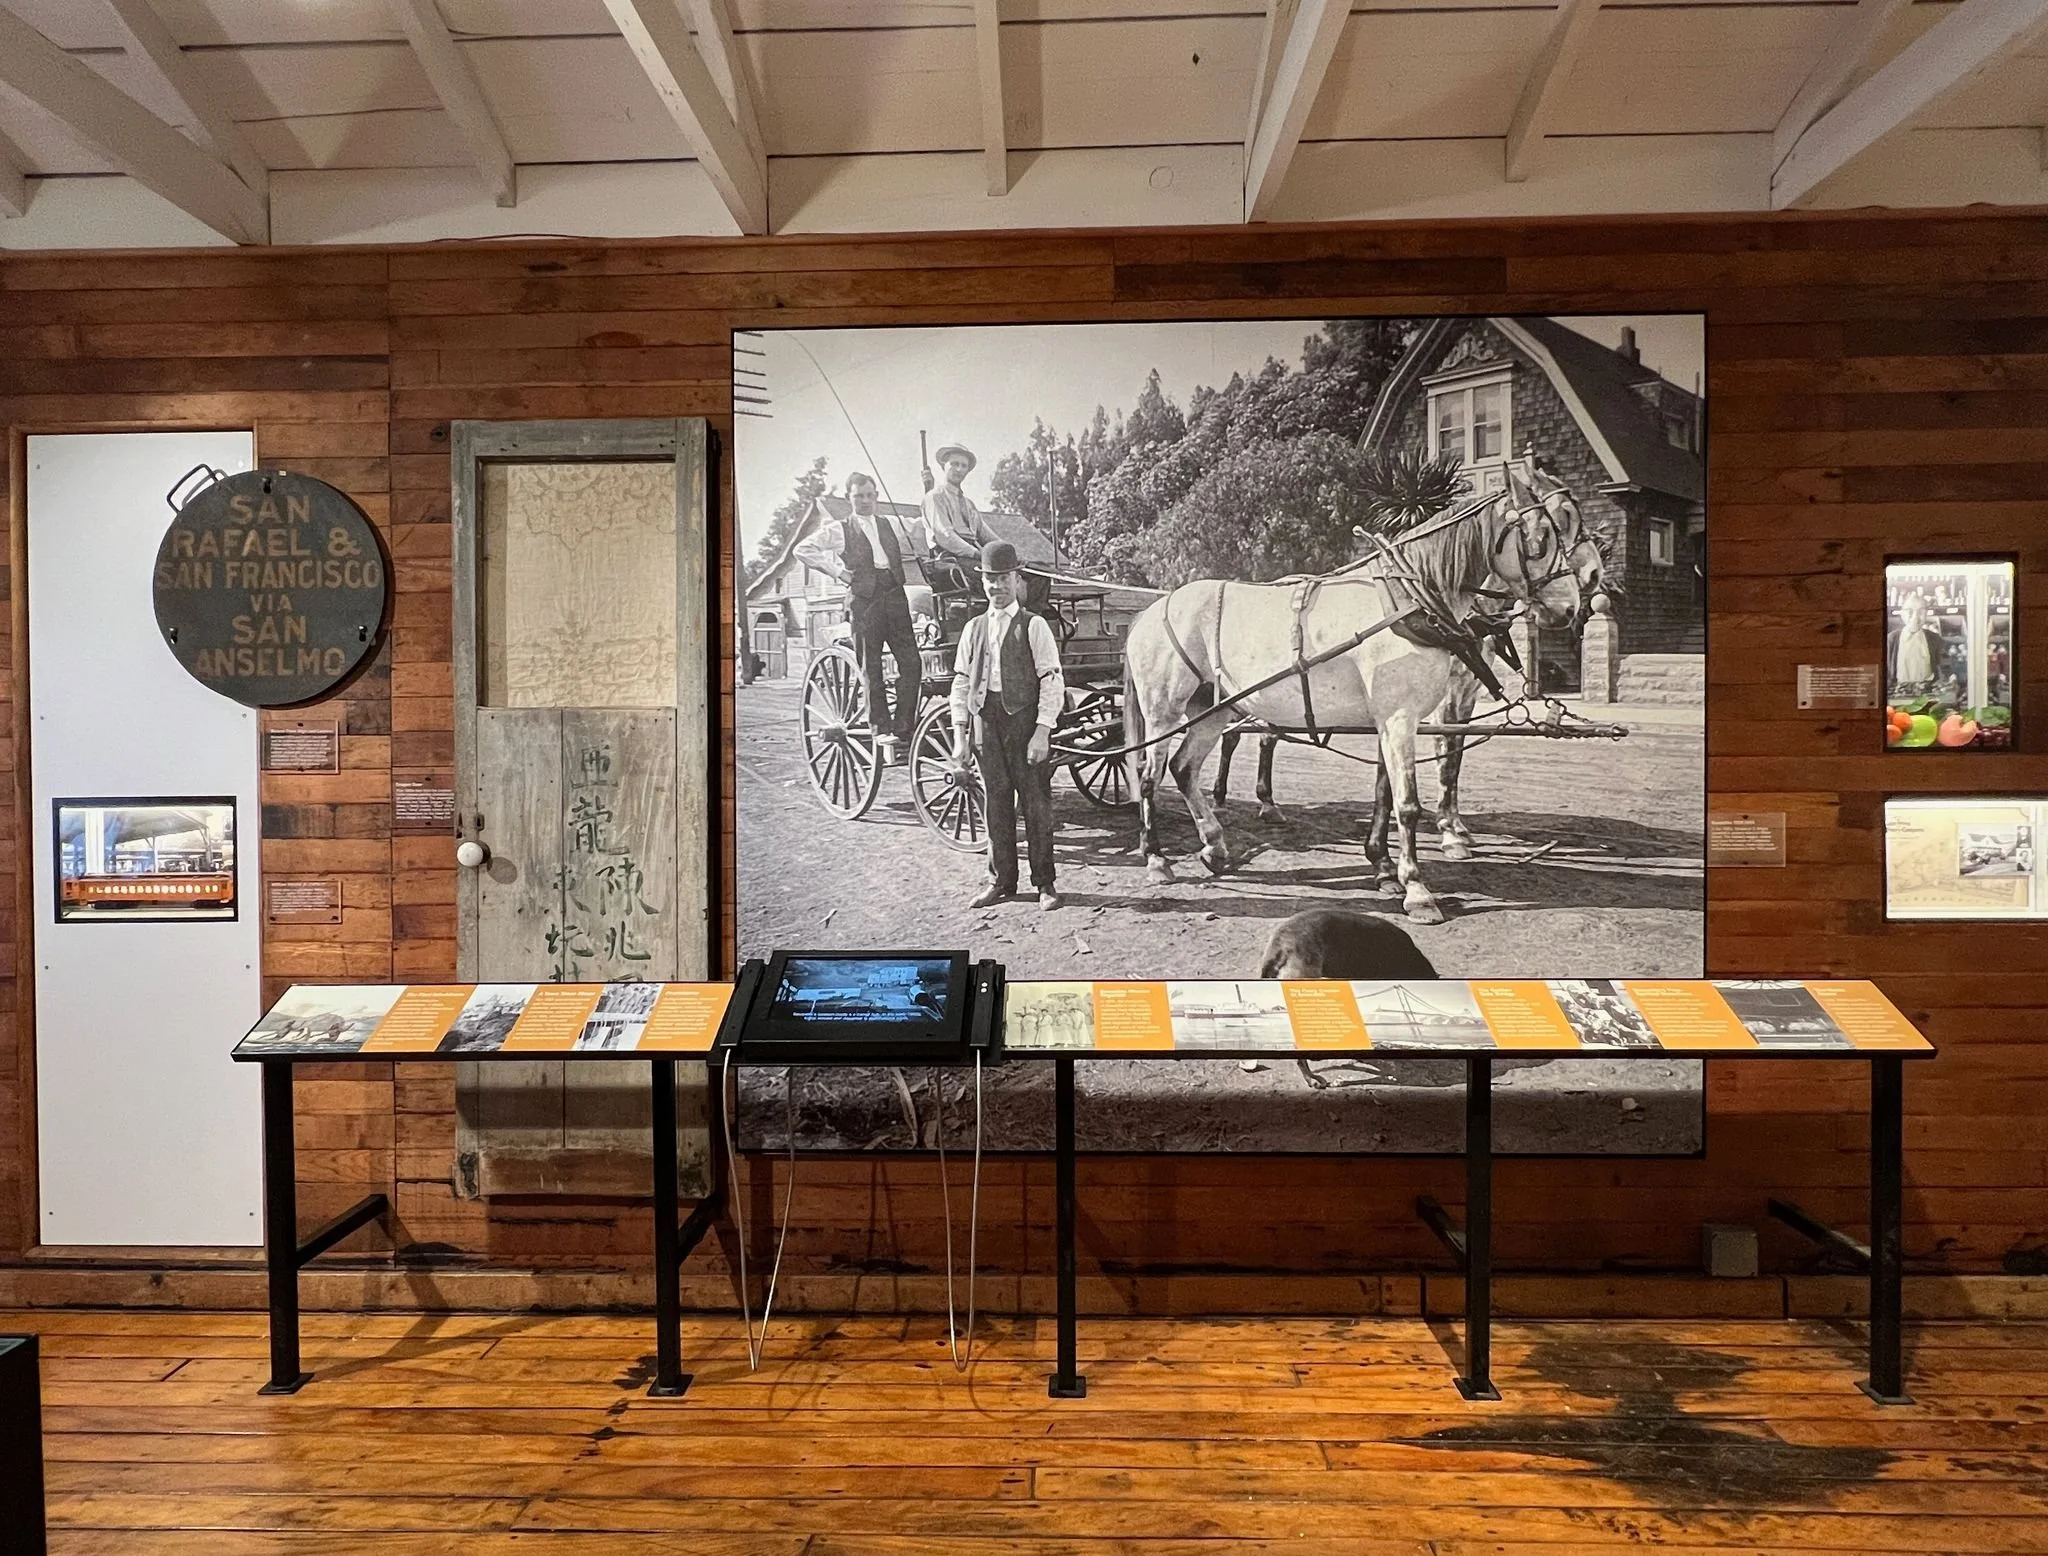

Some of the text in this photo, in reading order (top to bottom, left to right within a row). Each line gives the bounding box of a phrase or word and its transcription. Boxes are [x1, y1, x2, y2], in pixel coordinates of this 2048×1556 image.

[230, 495, 311, 525] SAN
[172, 527, 362, 558] RAFAEL &
[156, 559, 381, 589] SAN FRANCISCO
[250, 594, 293, 613] VIA
[232, 614, 308, 645] SAN
[195, 647, 346, 678] ANSELMO
